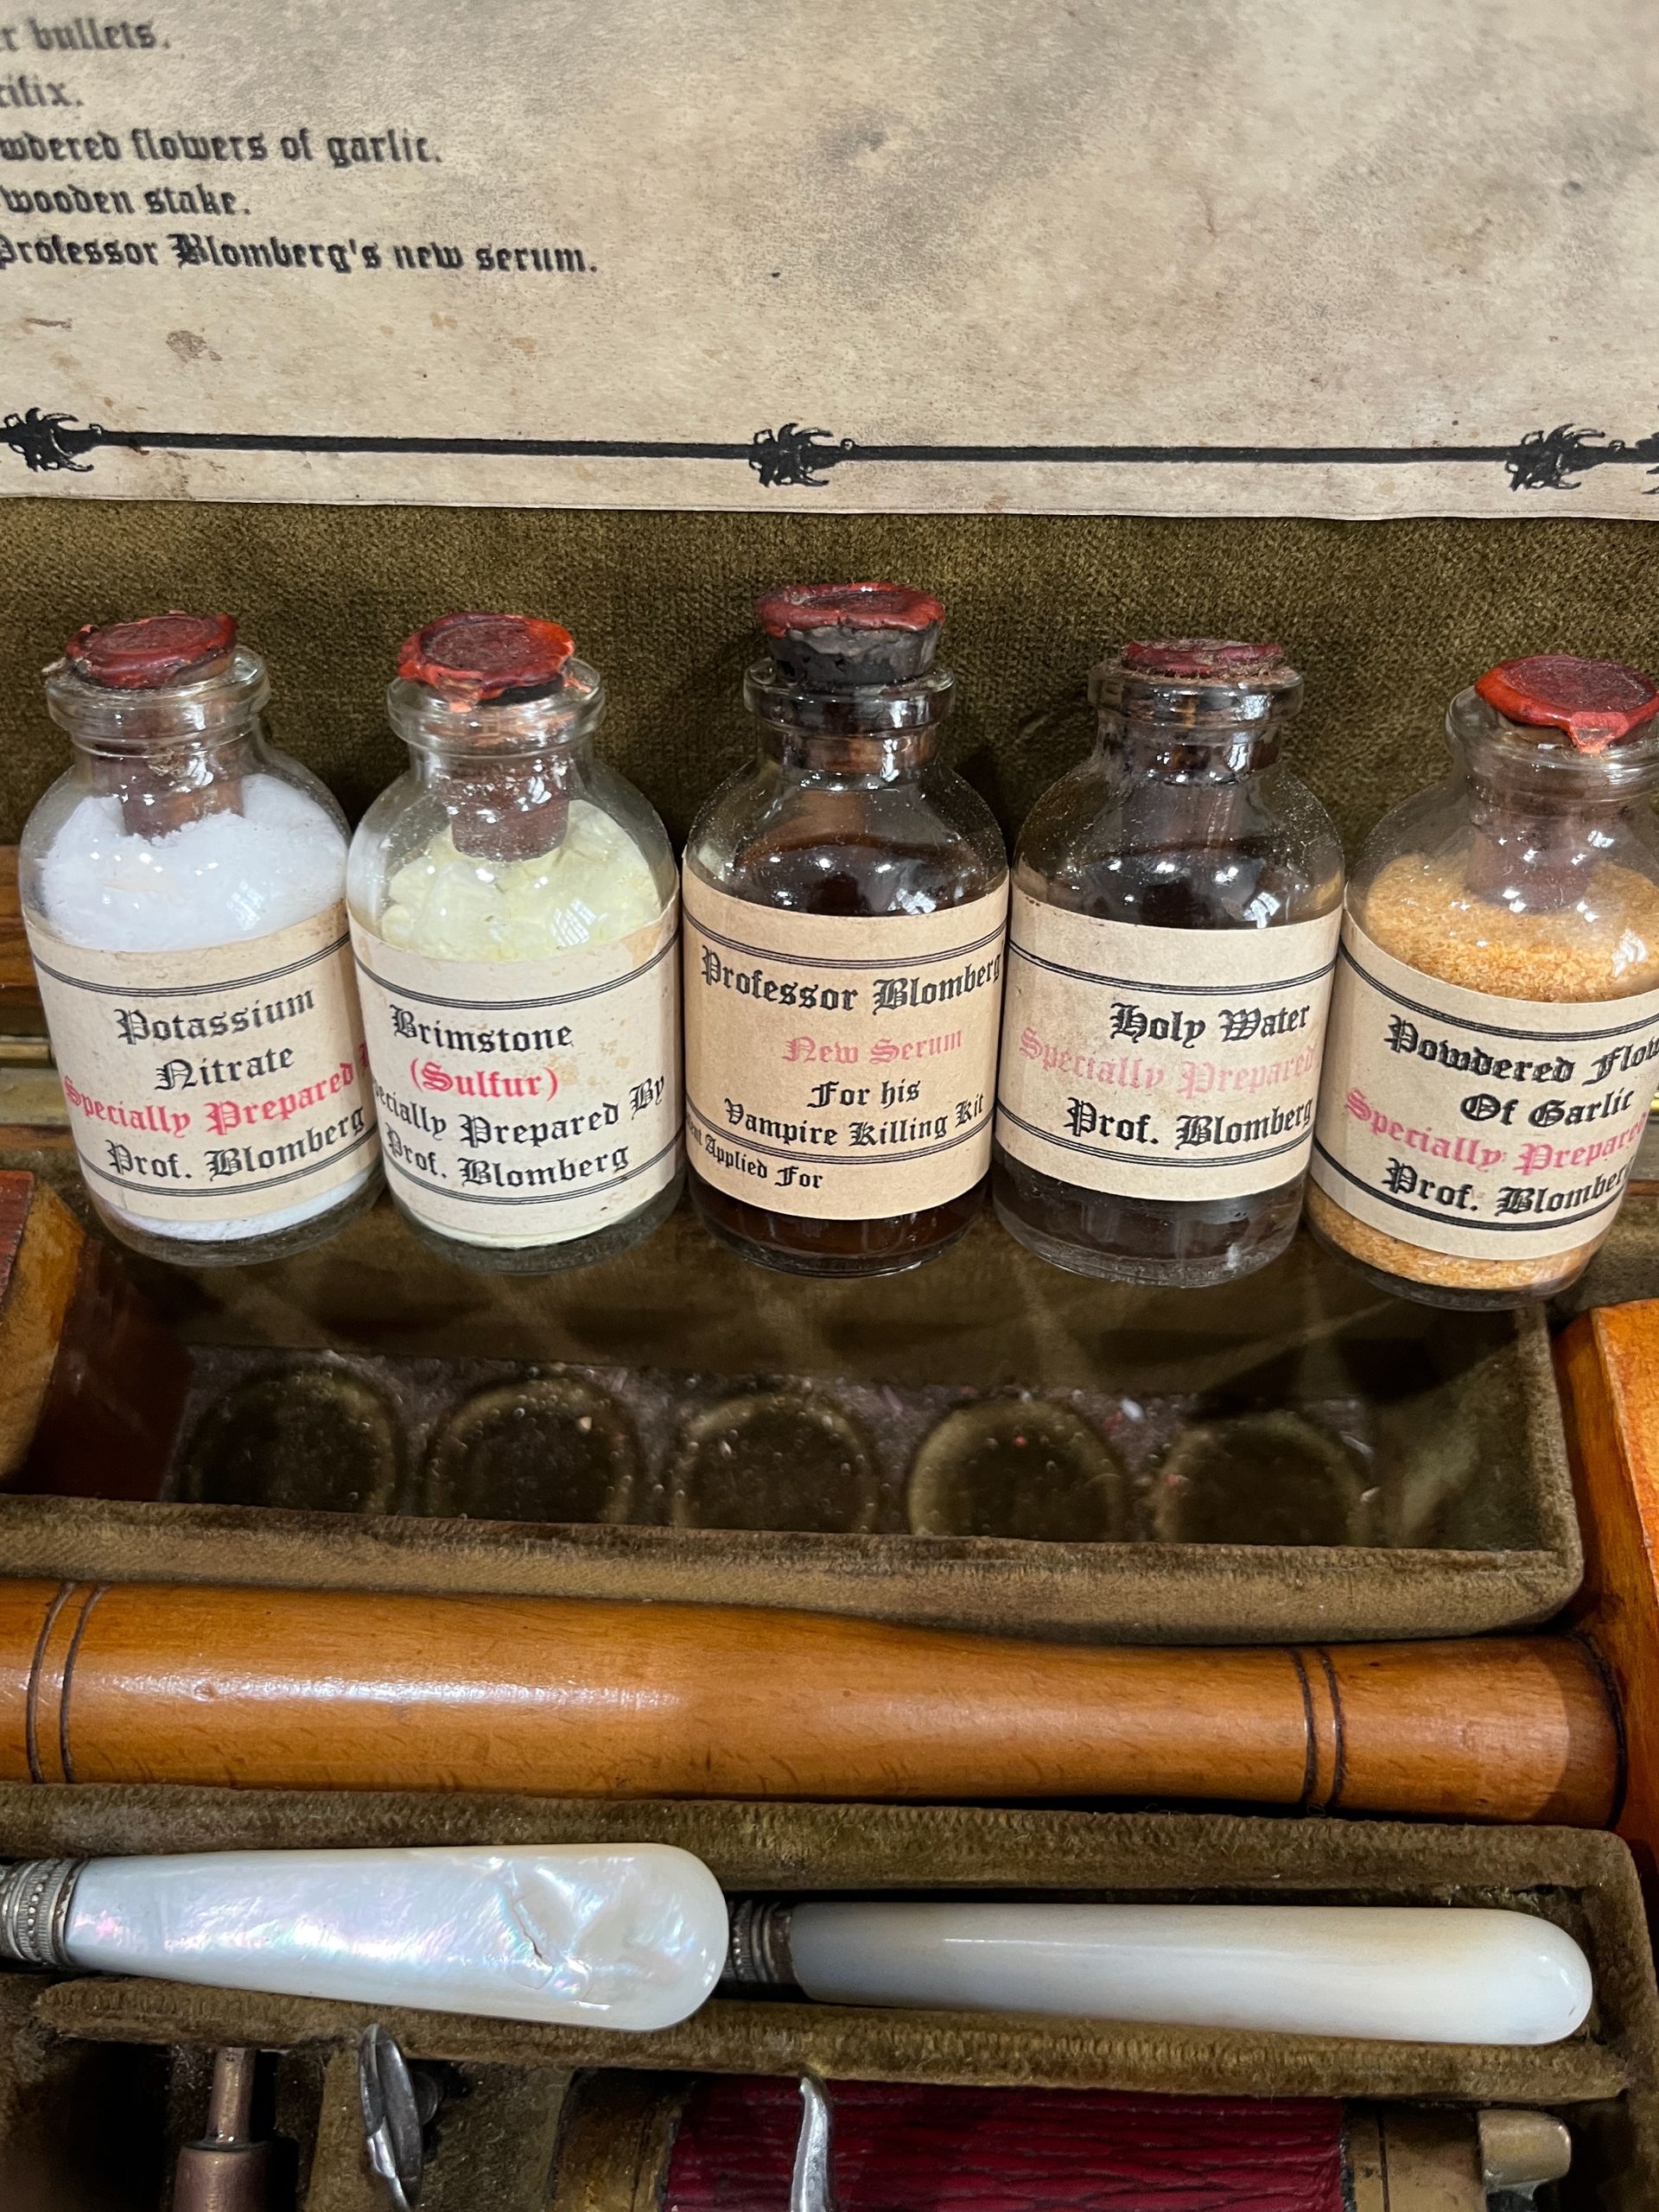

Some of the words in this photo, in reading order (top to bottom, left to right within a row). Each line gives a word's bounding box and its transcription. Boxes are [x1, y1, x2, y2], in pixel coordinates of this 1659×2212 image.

[29, 16, 171, 52] bullets.
[131, 127, 269, 162] flowers
[282, 127, 310, 162] of
[327, 128, 442, 168] garlic.
[0, 184, 136, 214] wooden
[146, 182, 251, 215] stake.
[168, 232, 379, 273] Blomberg's
[393, 241, 463, 270] new
[476, 245, 598, 273] serum.
[702, 944, 859, 1011] Professor
[113, 989, 315, 1045] Potassium
[390, 1004, 574, 1053] Brimstone
[1109, 1001, 1206, 1049] Holy
[1217, 1004, 1311, 1042] Water
[155, 1047, 294, 1090] Nitrate
[782, 1035, 859, 1065] New
[869, 1029, 962, 1065] Serum
[1019, 1027, 1165, 1090] Specially
[1176, 1044, 1317, 1099] Prepared
[1383, 1014, 1575, 1083] Powdered
[64, 1075, 192, 1138] Specially
[203, 1062, 354, 1136] Prepared
[410, 1058, 560, 1102] (Sulfur)
[806, 1080, 870, 1109] For
[880, 1078, 921, 1109] his
[1460, 1093, 1519, 1126] Of
[1528, 1086, 1635, 1128] Garlic
[373, 1079, 448, 1141] ecially
[459, 1102, 620, 1148] Prepared
[629, 1075, 665, 1121] By
[724, 1098, 838, 1147] Vampire
[848, 1115, 949, 1147] Killing
[955, 1093, 985, 1128] Kit
[1066, 1096, 1159, 1146] Prof.
[1175, 1097, 1313, 1150] Blomberg
[1344, 1089, 1502, 1171] Specially
[1514, 1112, 1647, 1176] Prepared
[105, 1139, 192, 1179] Prof.
[204, 1106, 365, 1181] Blomberg
[385, 1122, 448, 1179] Prof.
[457, 1146, 629, 1187] Blomberg
[705, 1134, 767, 1179] Applied
[774, 1165, 823, 1189] For
[1382, 1157, 1478, 1211] Prof.
